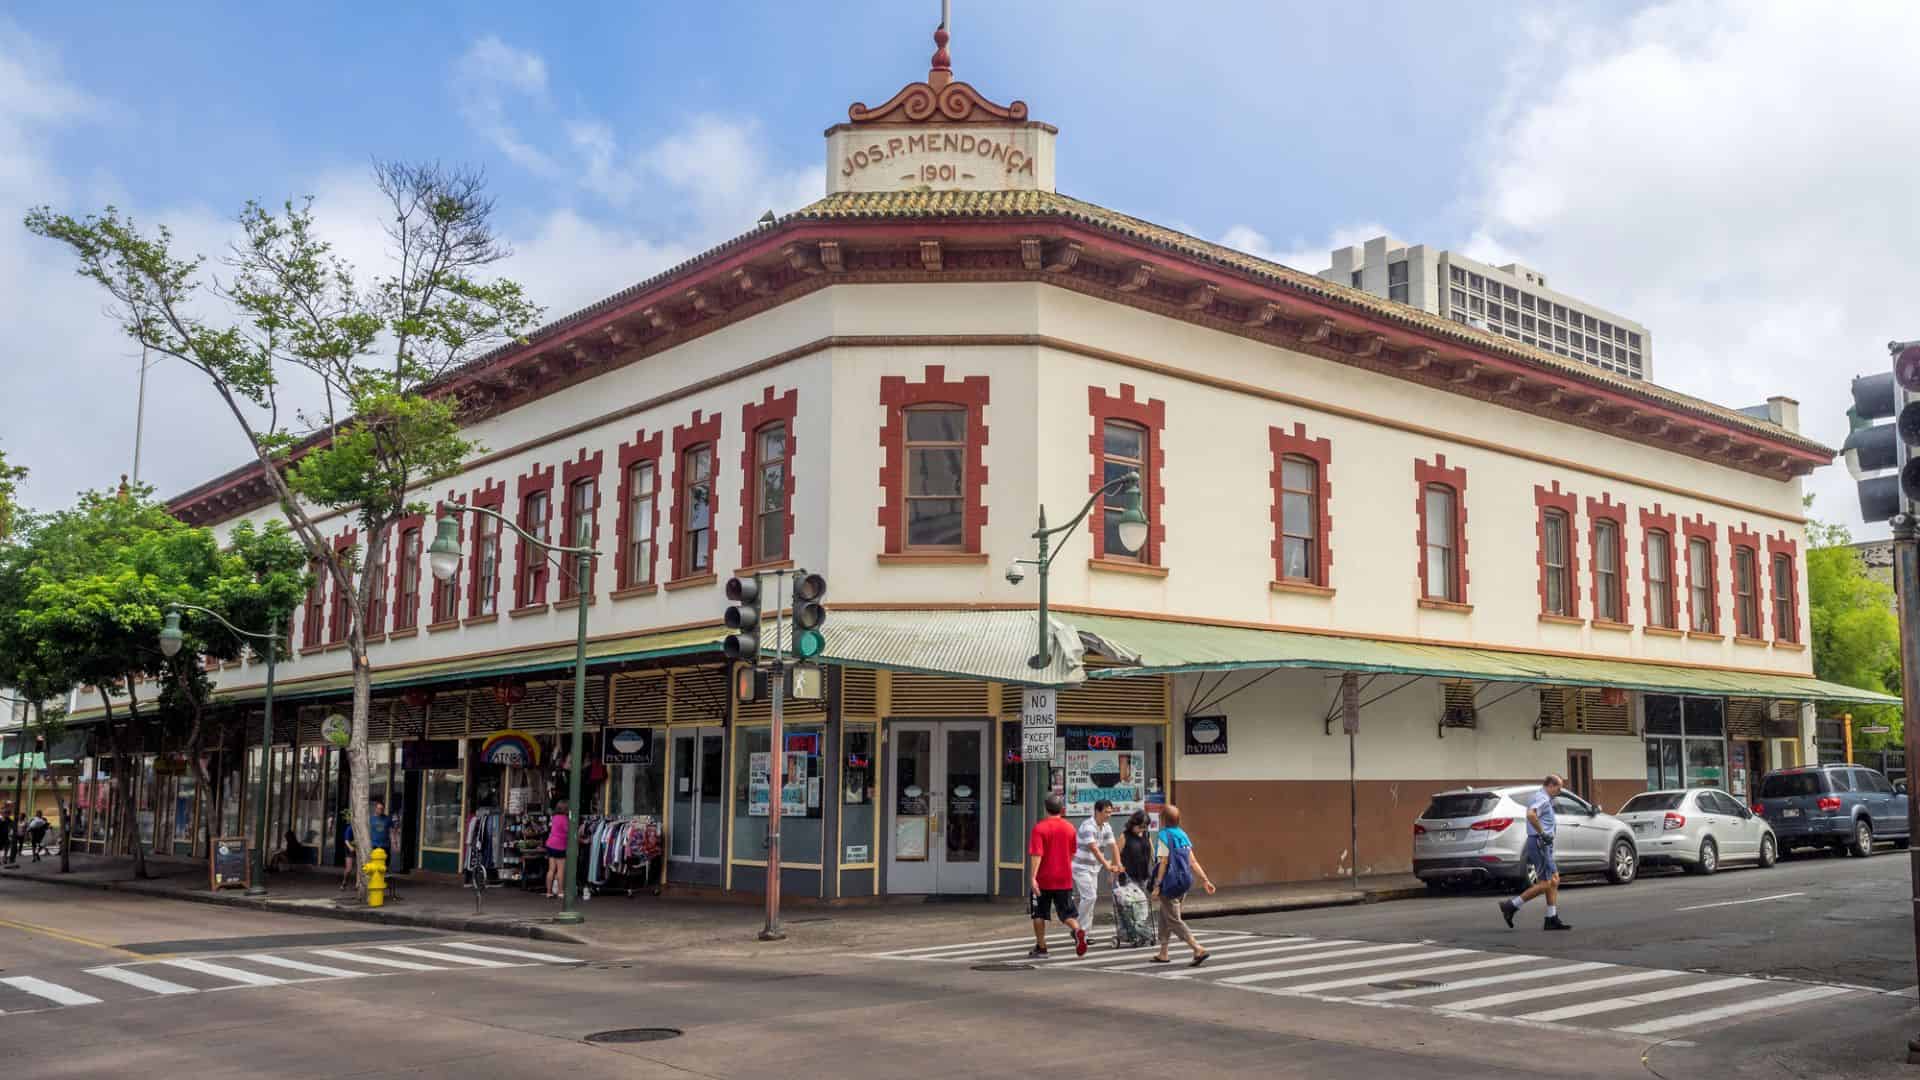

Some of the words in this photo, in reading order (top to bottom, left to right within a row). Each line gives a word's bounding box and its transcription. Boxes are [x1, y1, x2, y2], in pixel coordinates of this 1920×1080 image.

[920, 165, 956, 181] 1901
[1031, 695, 1047, 708] NO
[1024, 714, 1054, 725] TURNS
[1024, 732, 1053, 743] EXCEPT
[1088, 735, 1116, 748] OPEN
[1026, 744, 1050, 754] BIKES
